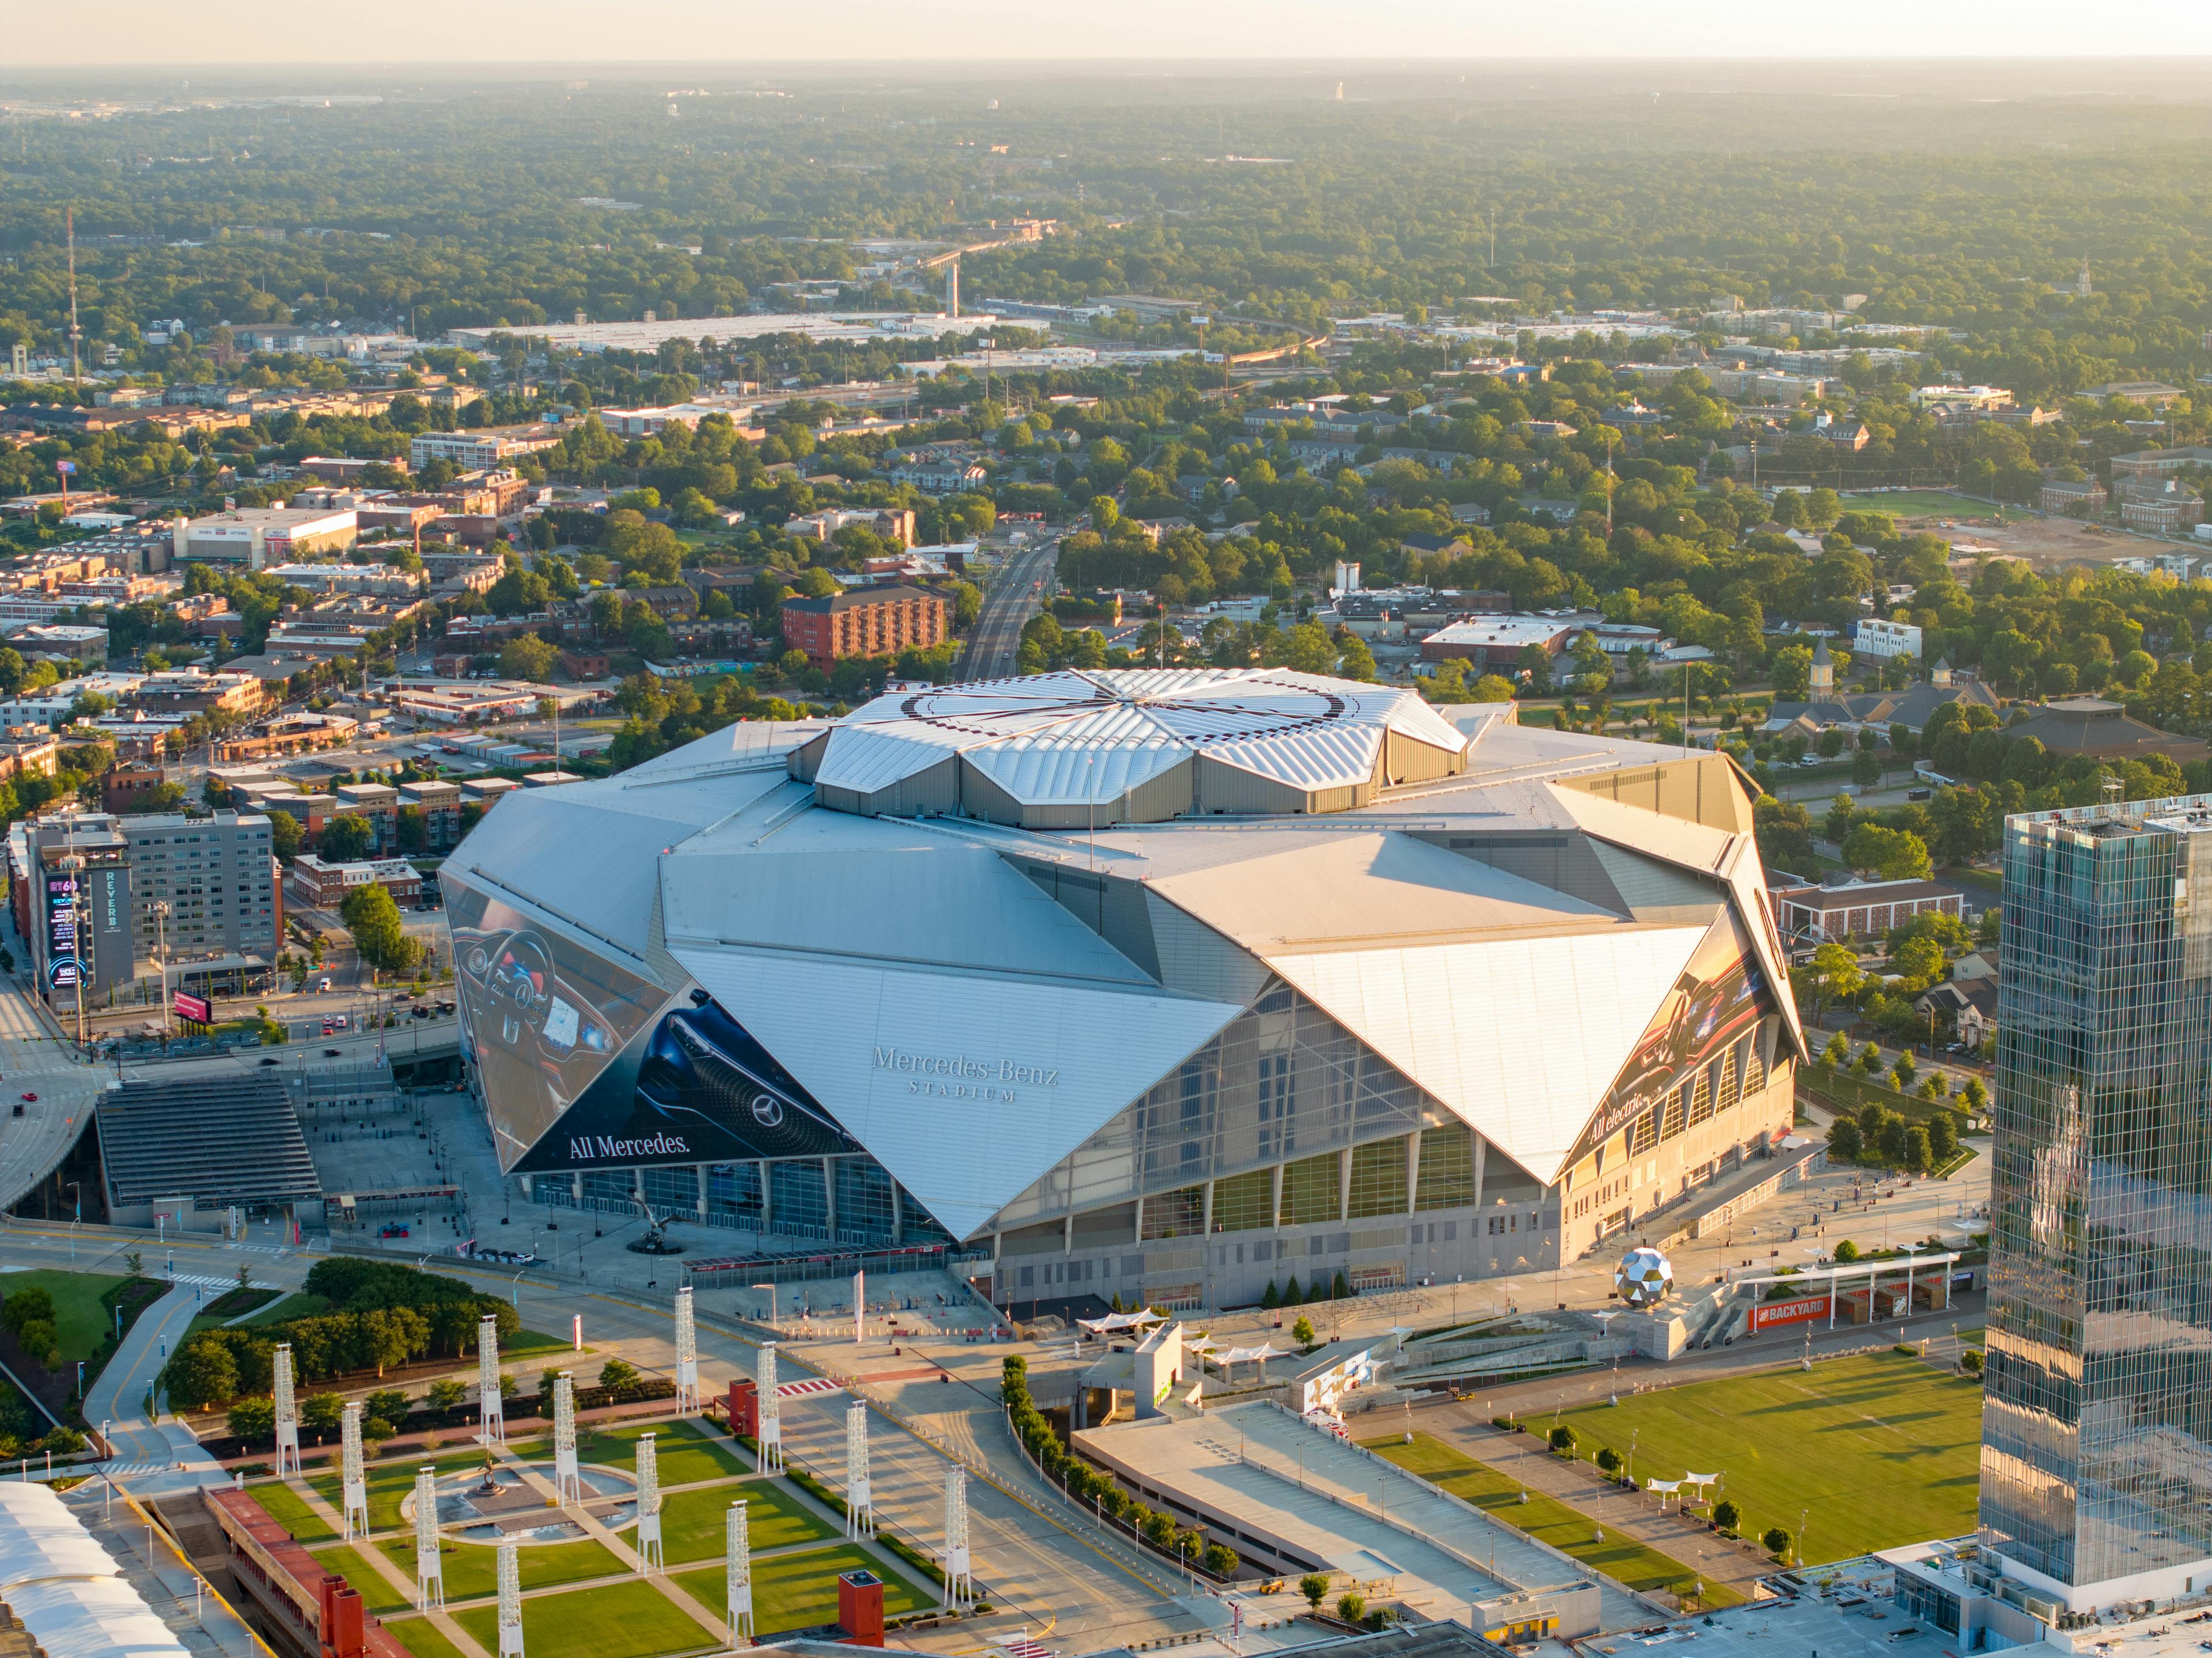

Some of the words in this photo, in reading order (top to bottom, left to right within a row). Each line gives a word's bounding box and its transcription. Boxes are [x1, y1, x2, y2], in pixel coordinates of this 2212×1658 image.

[50, 881, 78, 892] RT60
[106, 872, 117, 926] REVERB
[871, 1046, 1058, 1086] Mercedes-Benz
[908, 1081, 1015, 1102] STADIUM
[1589, 1116, 1605, 1145] All
[1605, 1092, 1642, 1132] electric.
[570, 1137, 596, 1159] All
[596, 1132, 690, 1157] Mercedes.
[1769, 1300, 1824, 1320] BACKYARD
